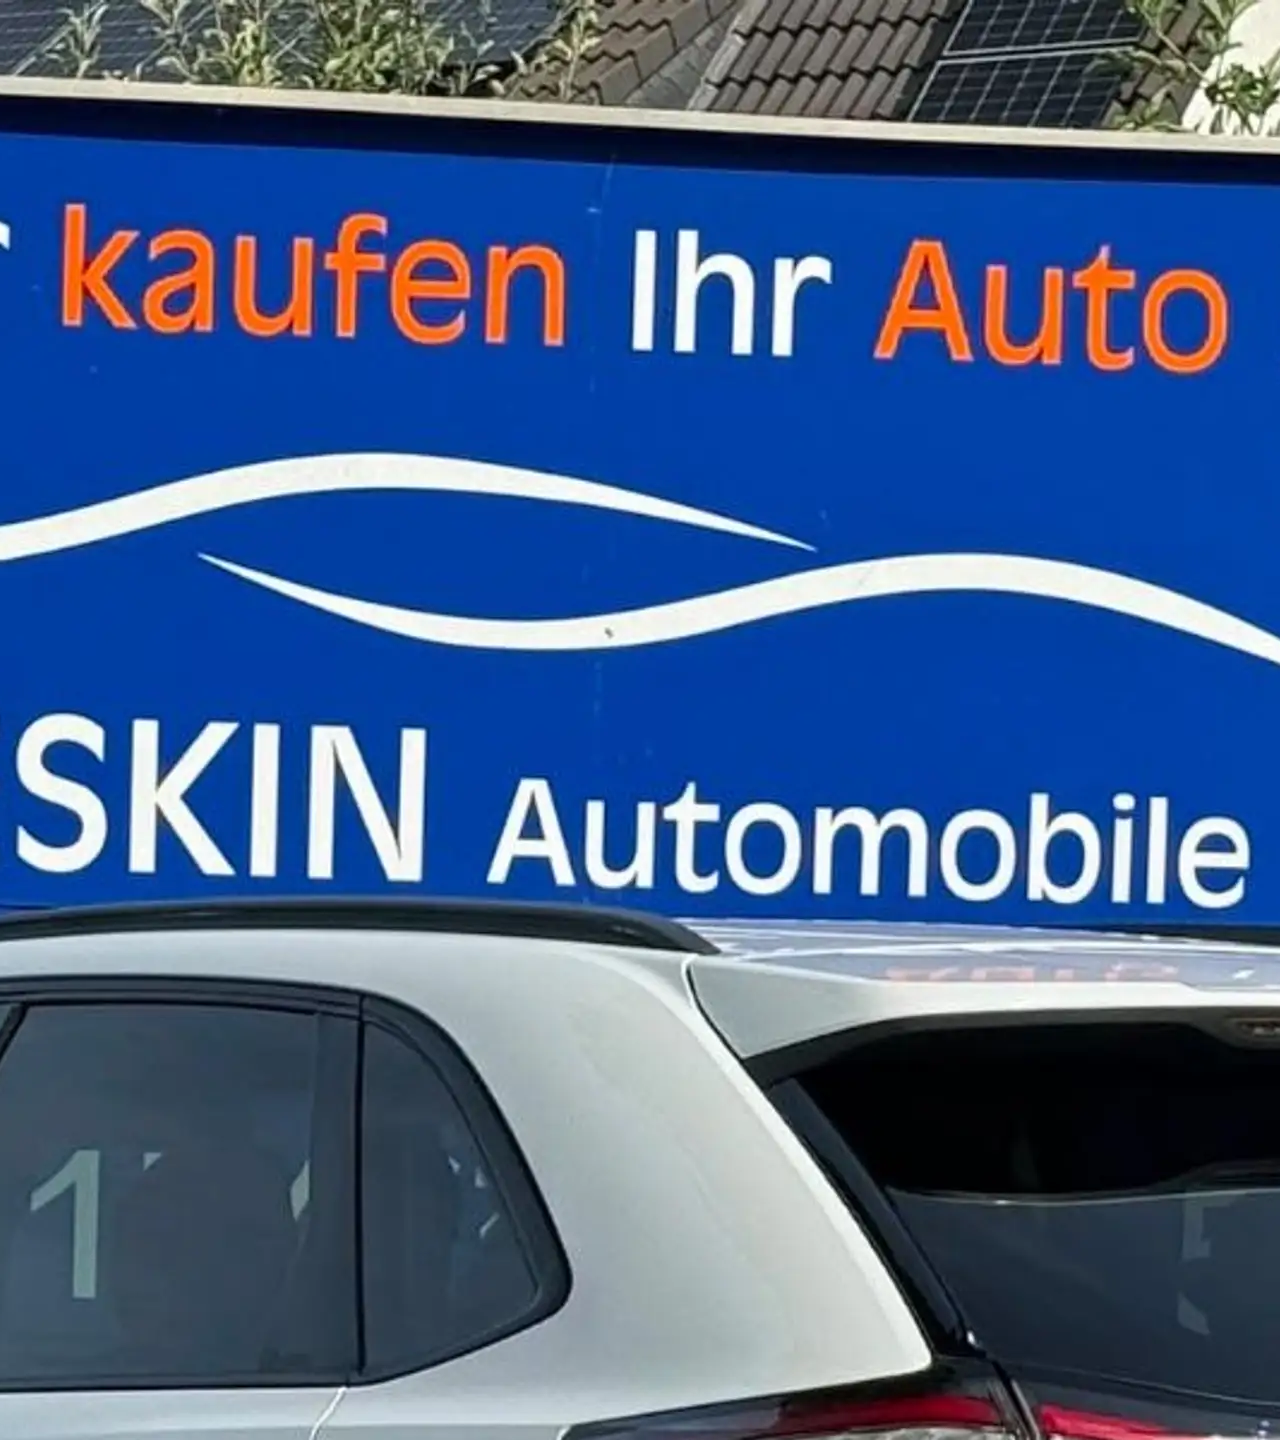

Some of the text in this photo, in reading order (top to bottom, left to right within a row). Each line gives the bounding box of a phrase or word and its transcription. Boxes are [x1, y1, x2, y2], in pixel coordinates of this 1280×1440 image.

[59, 202, 567, 348] kaufen
[631, 228, 832, 357] Ihr
[873, 238, 1230, 375] Auto
[486, 777, 1251, 910] Automobile
